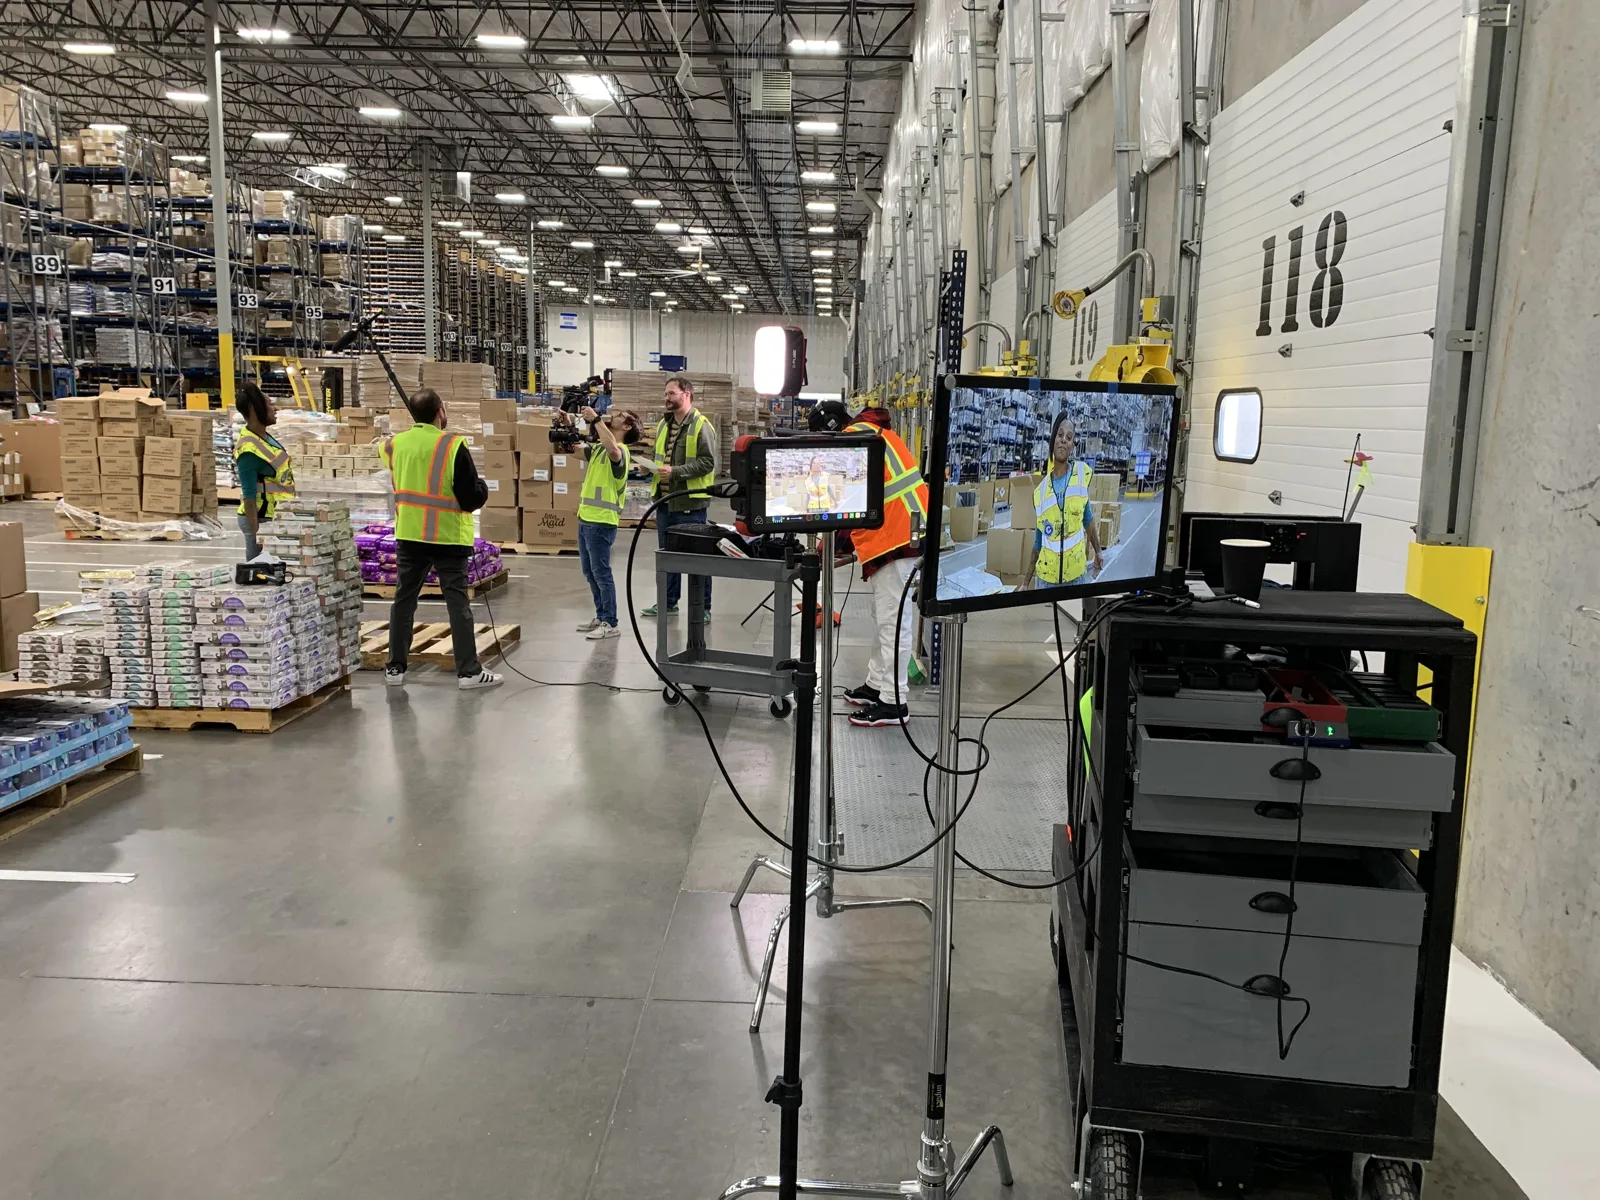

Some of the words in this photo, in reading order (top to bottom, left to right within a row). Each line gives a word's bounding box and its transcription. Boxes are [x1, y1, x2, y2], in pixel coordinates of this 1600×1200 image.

[34, 257, 60, 272] 89
[1255, 210, 1348, 337] 118
[153, 279, 174, 293] 91
[239, 295, 257, 307] 93
[306, 307, 322, 318] 95
[443, 332, 456, 341] 103
[1070, 299, 1099, 366] 119
[465, 336, 476, 344] 105
[485, 340, 495, 348] 107
[501, 343, 511, 351] 109
[537, 516, 566, 528] Maid
